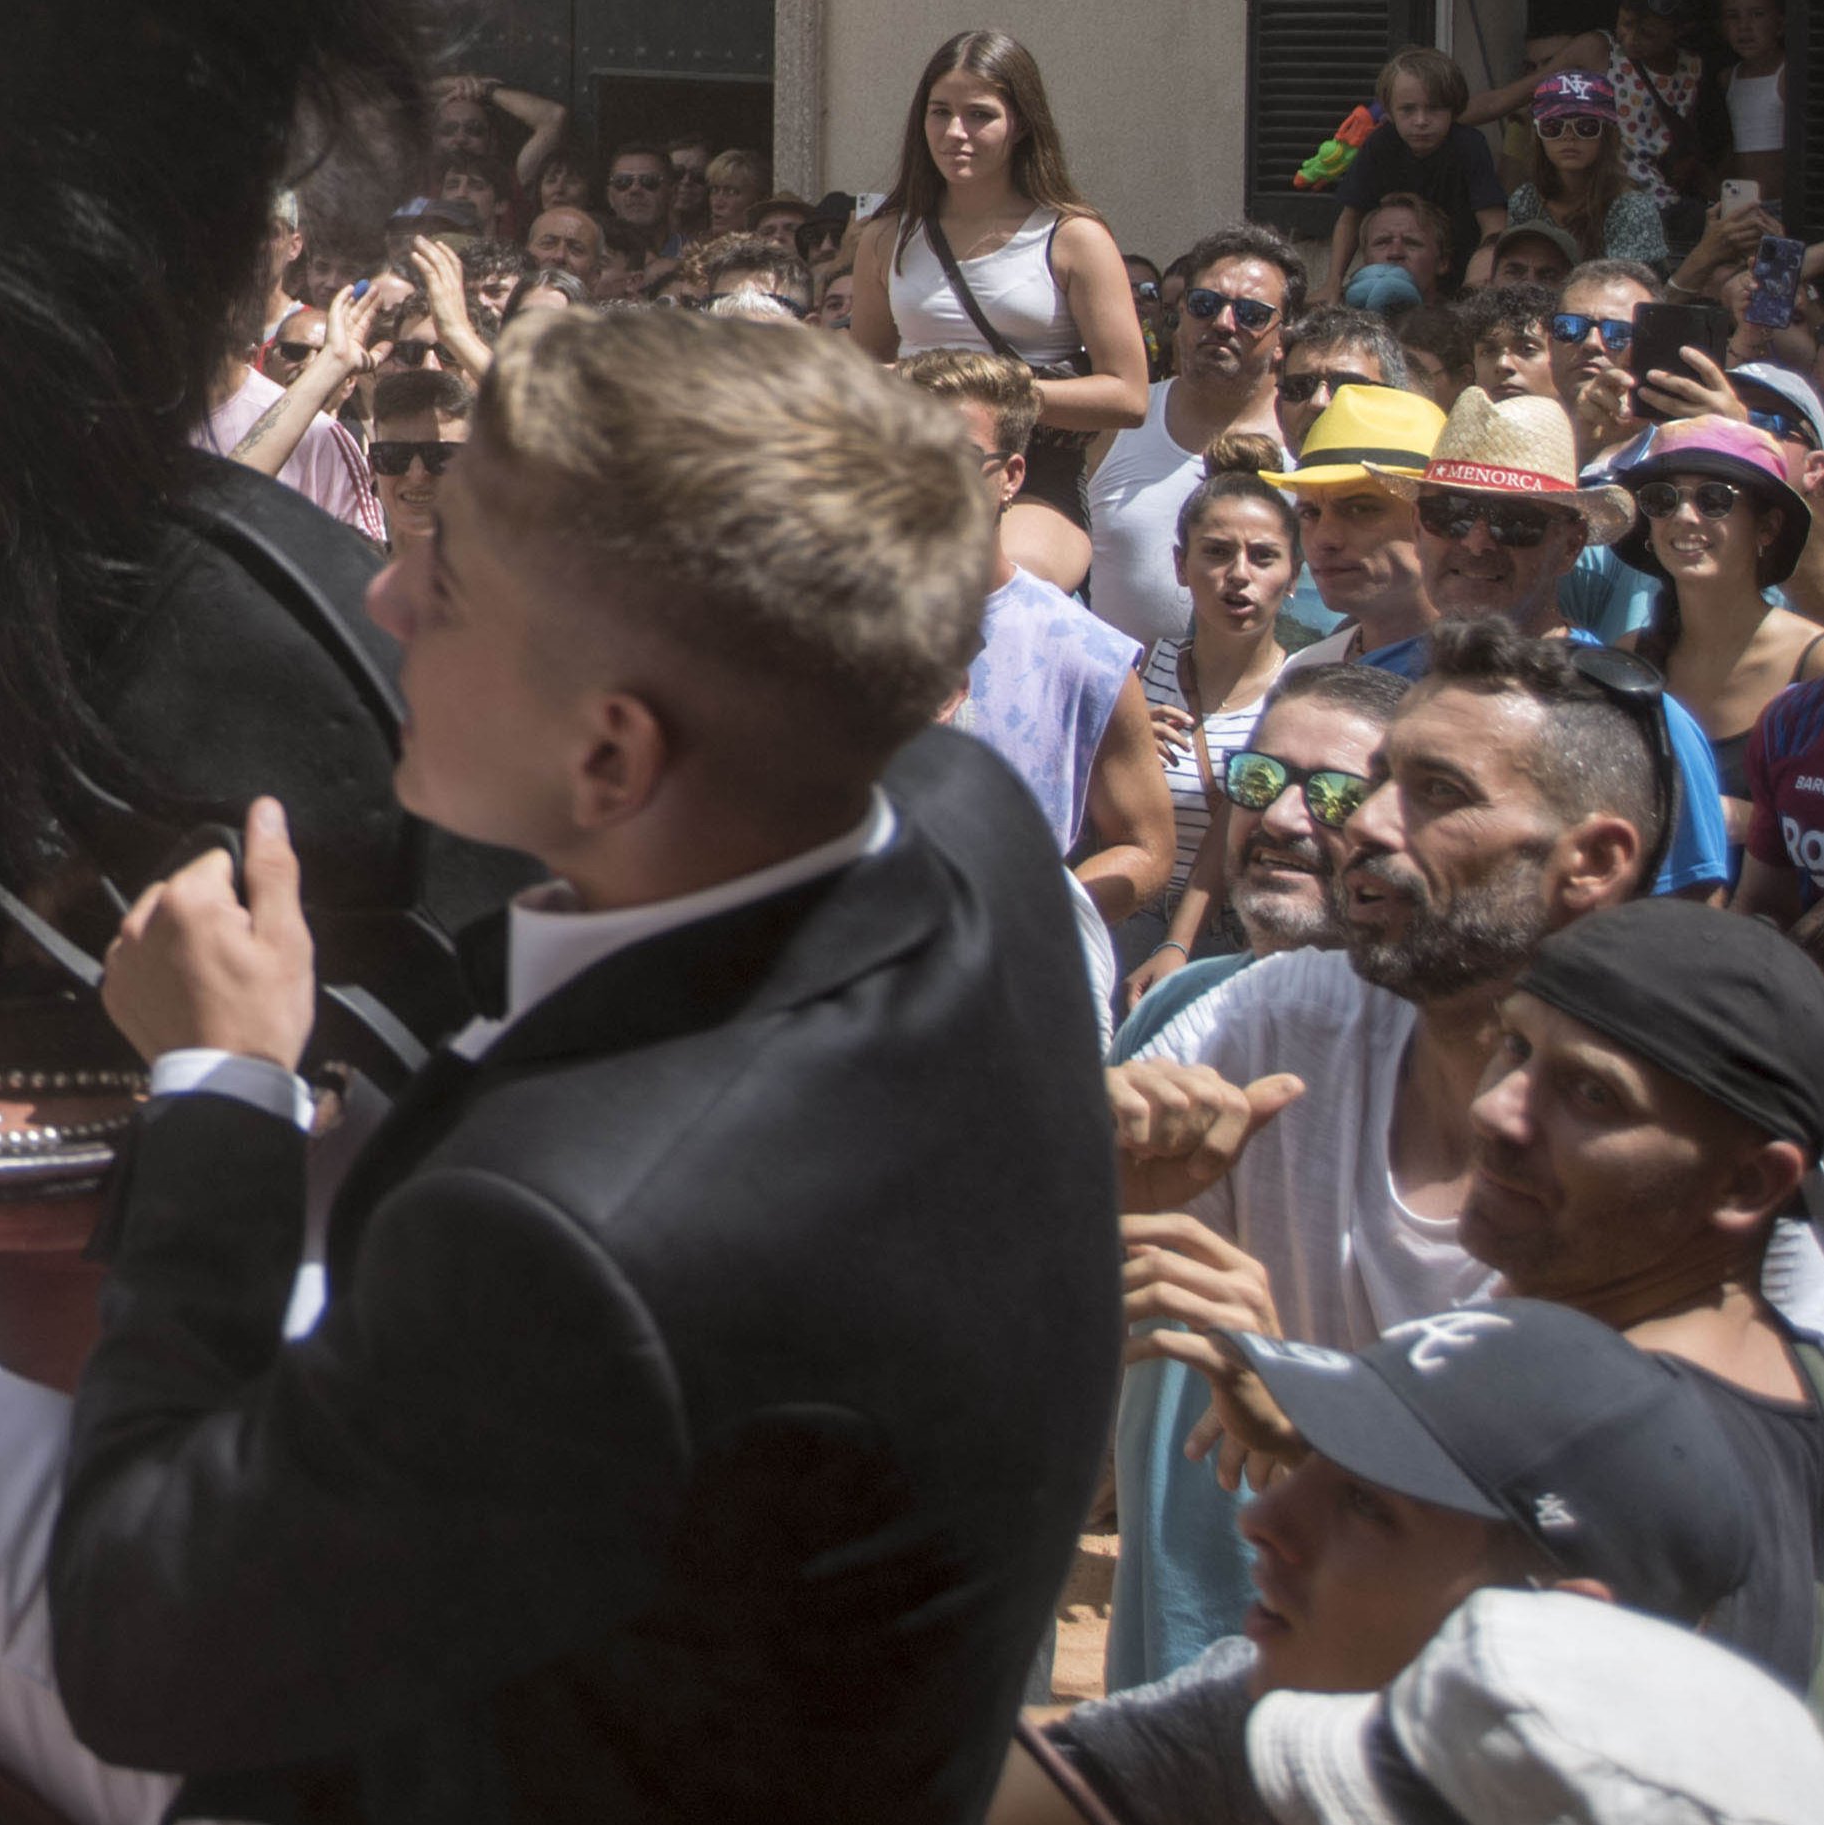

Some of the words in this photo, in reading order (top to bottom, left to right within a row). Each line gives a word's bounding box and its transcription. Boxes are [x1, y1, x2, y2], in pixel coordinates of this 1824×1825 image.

[1557, 73, 1593, 100] NY
[1447, 464, 1543, 492] MENORCA
[1795, 775, 1824, 796] BAR
